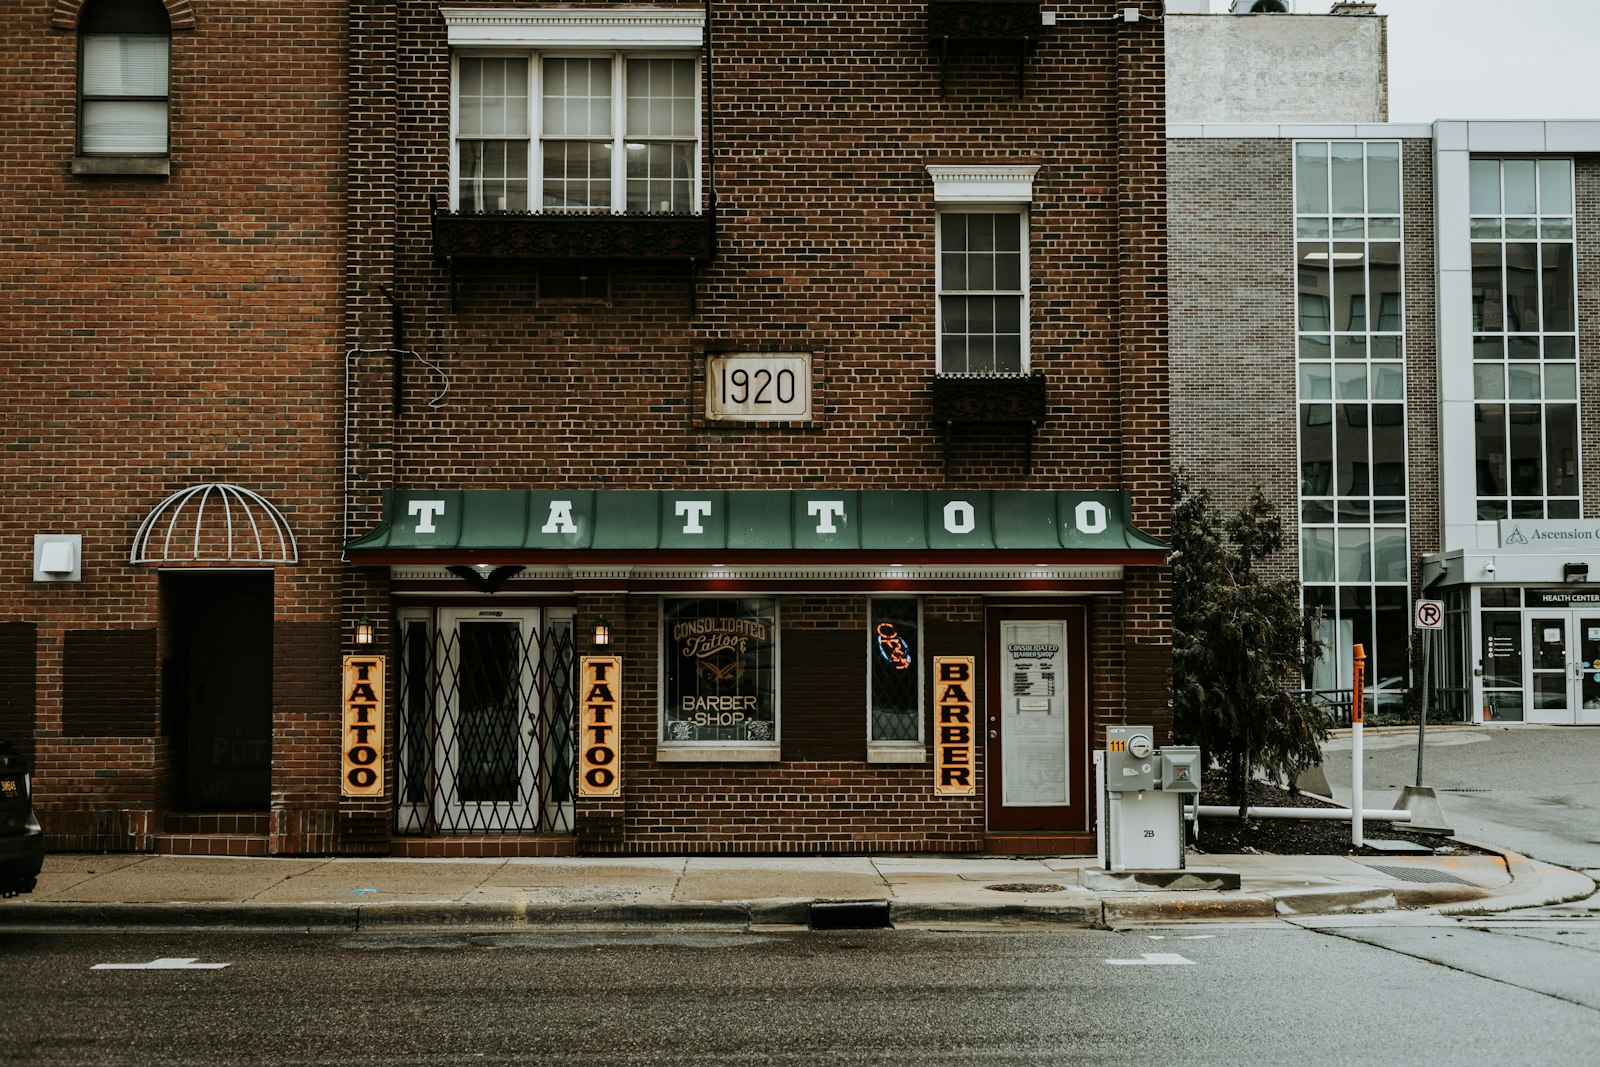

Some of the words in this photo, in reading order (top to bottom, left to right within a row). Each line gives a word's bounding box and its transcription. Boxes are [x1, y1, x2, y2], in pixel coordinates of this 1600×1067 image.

[722, 369, 795, 404] 1920
[407, 499, 1108, 534] TATTOO
[1532, 528, 1592, 539] Ascension
[1542, 594, 1571, 602] HEALTH
[1571, 594, 1600, 602] CENTER
[673, 617, 768, 643] CONSOLIDATED
[682, 633, 742, 658] Tattoo
[682, 695, 757, 711] BARBER
[346, 661, 380, 788] TATTOO
[584, 661, 616, 788] TATTOO
[694, 712, 745, 726] SHOP
[939, 662, 972, 786] BARBER
[1110, 741, 1125, 752] 111
[1143, 829, 1155, 838] 2B
